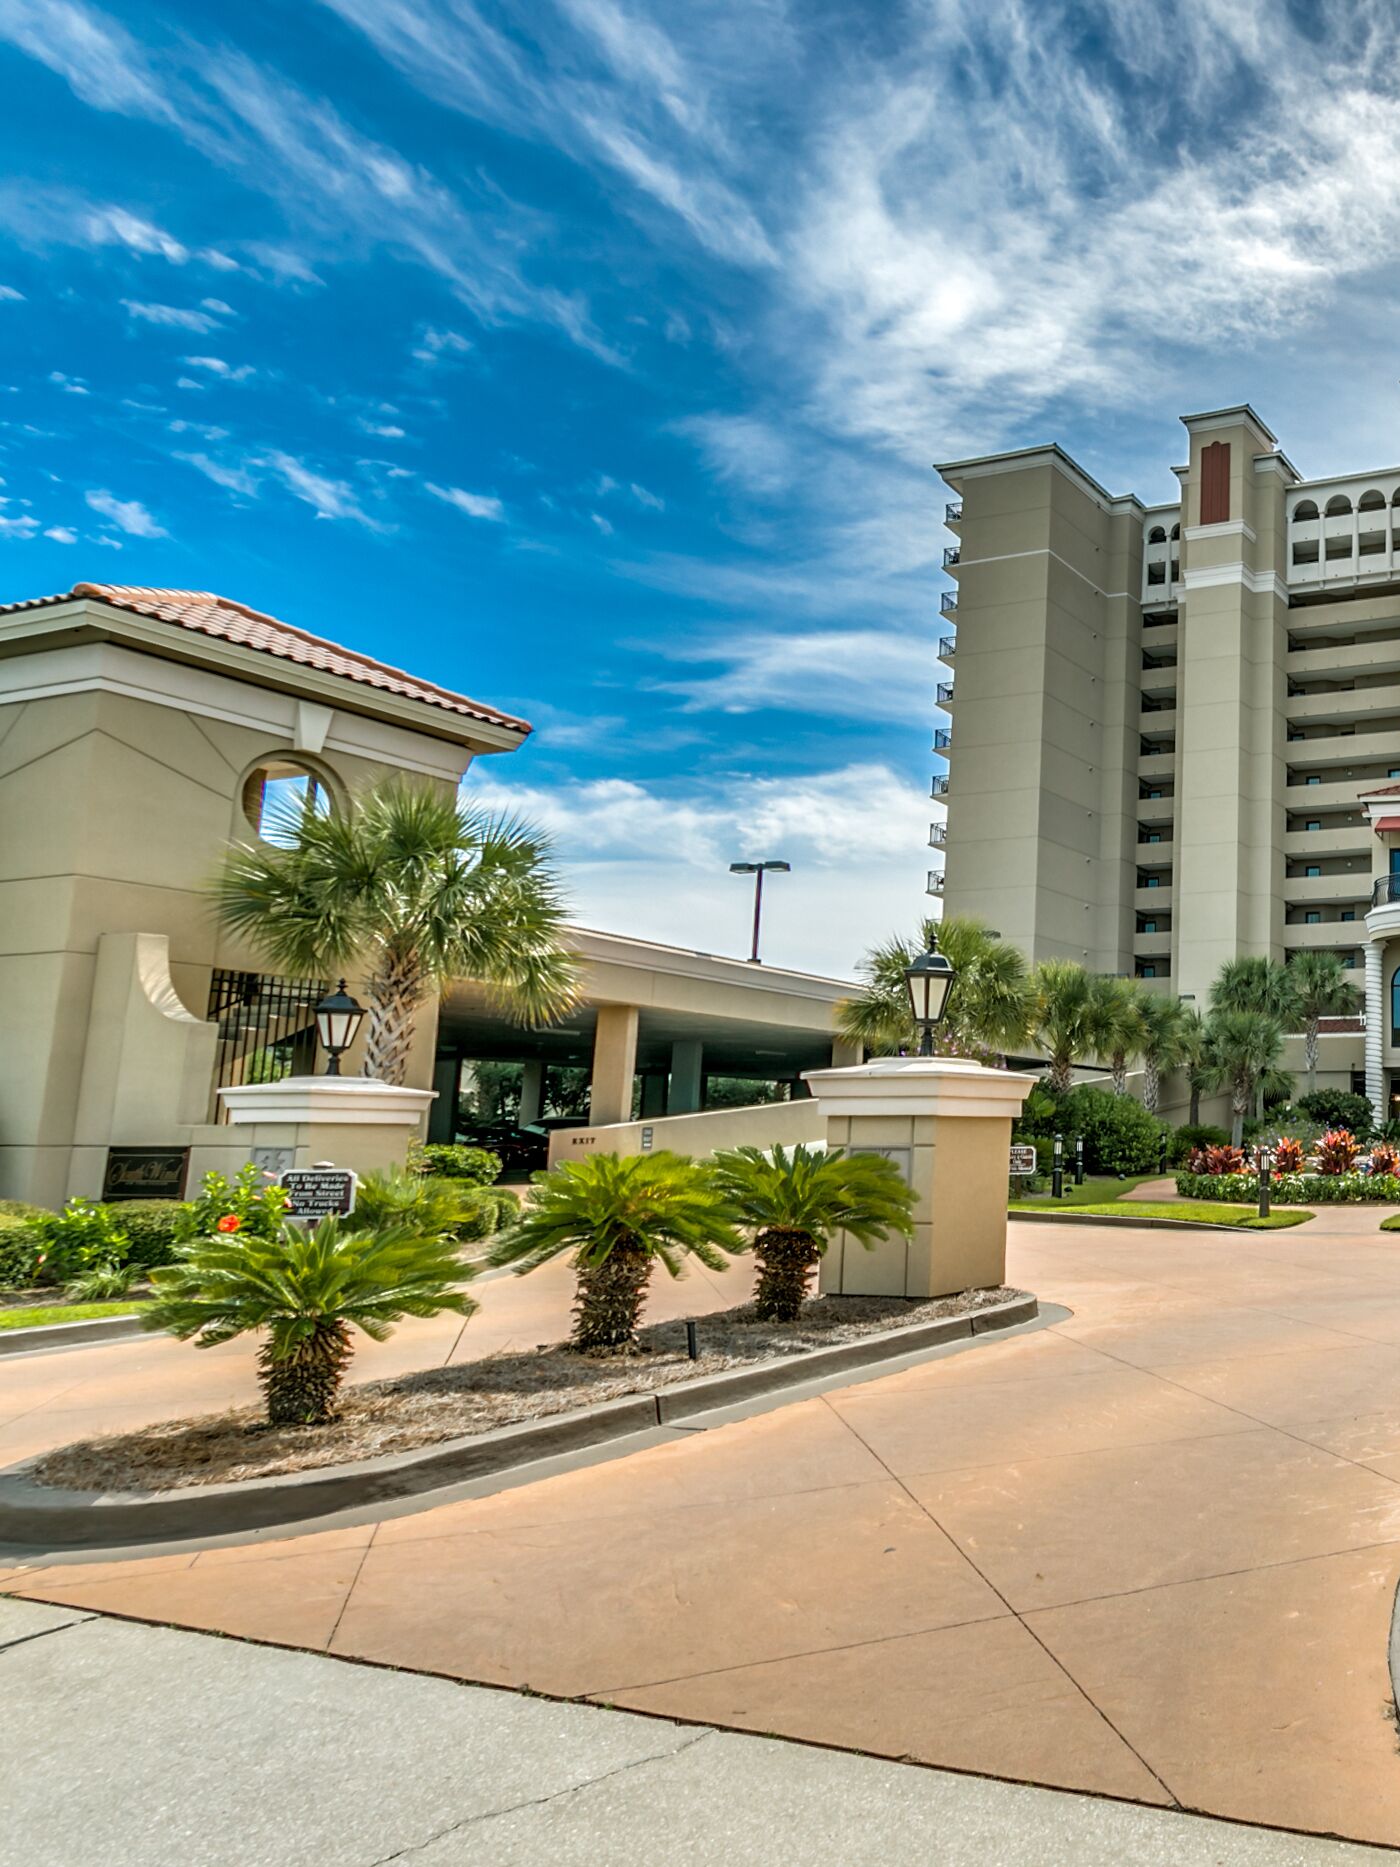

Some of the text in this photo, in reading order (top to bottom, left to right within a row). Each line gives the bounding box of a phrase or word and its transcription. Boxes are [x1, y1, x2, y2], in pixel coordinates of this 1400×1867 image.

[572, 1137, 596, 1145] EXIT
[290, 1182, 345, 1190] To Be Made
